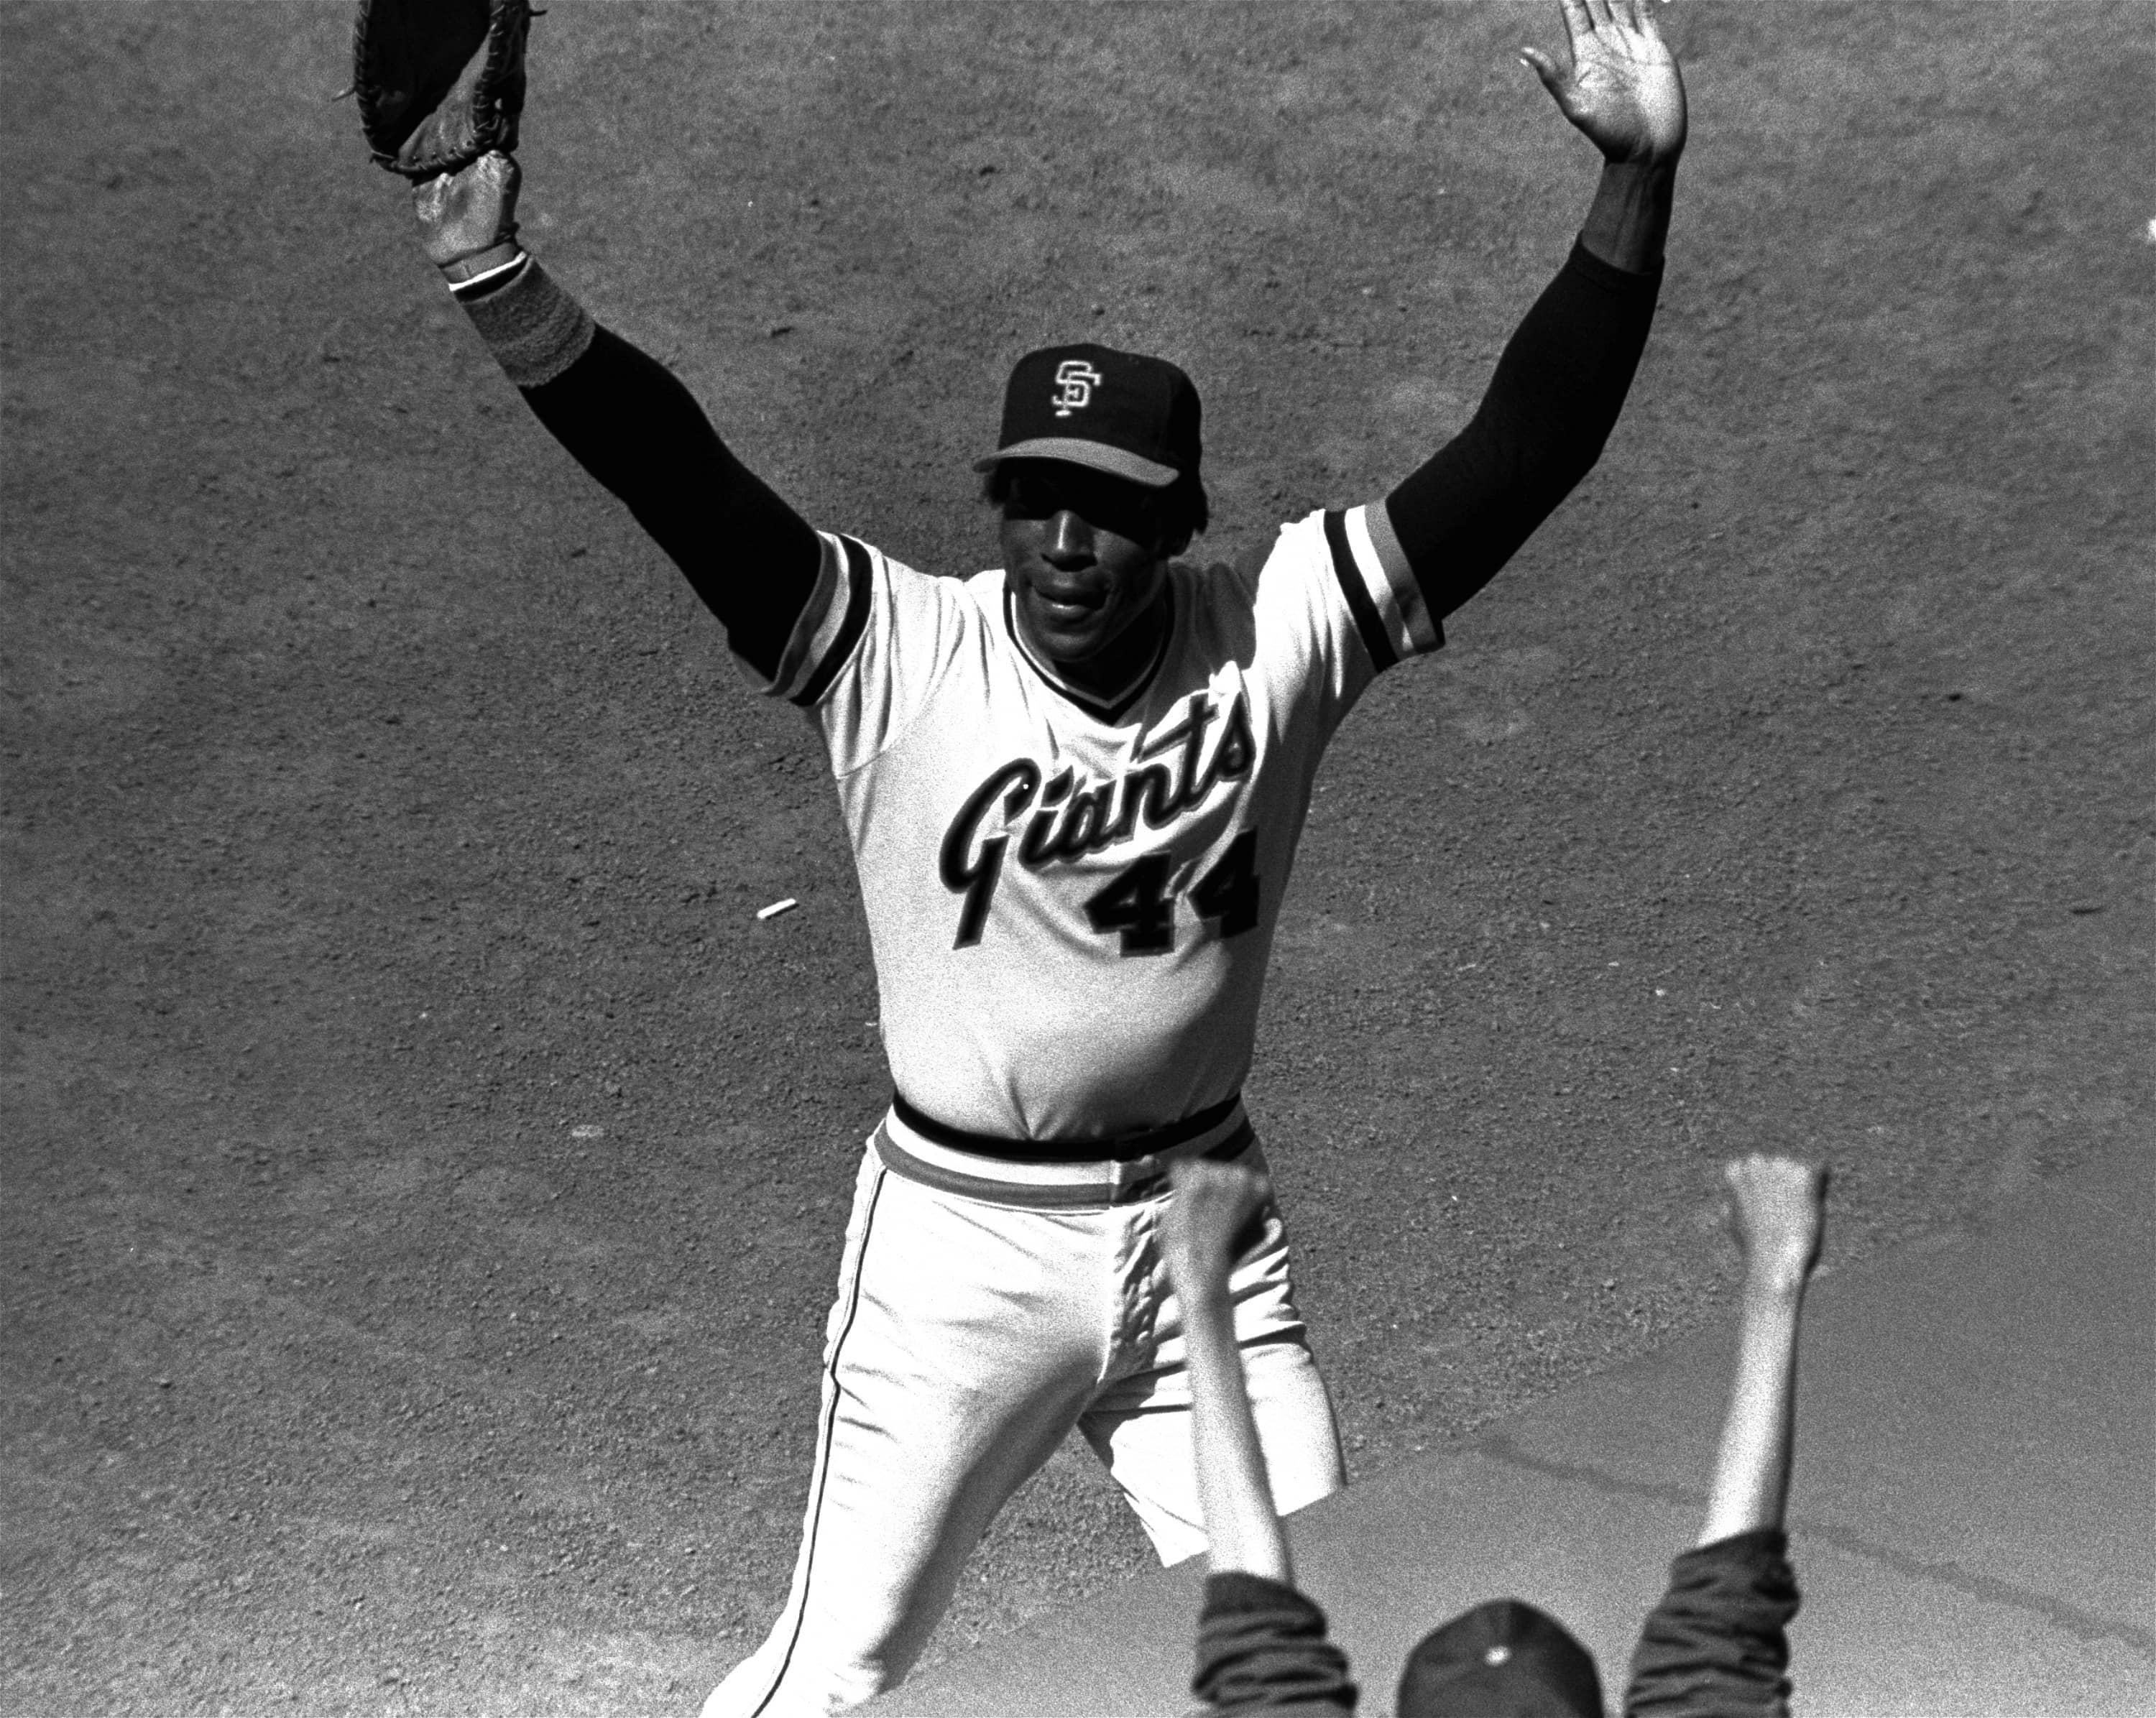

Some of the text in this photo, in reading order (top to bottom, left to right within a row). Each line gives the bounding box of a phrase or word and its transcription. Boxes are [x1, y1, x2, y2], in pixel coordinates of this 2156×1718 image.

[1051, 359, 1102, 417] SF
[939, 690, 1257, 951] Giants
[1082, 826, 1261, 958] 44
